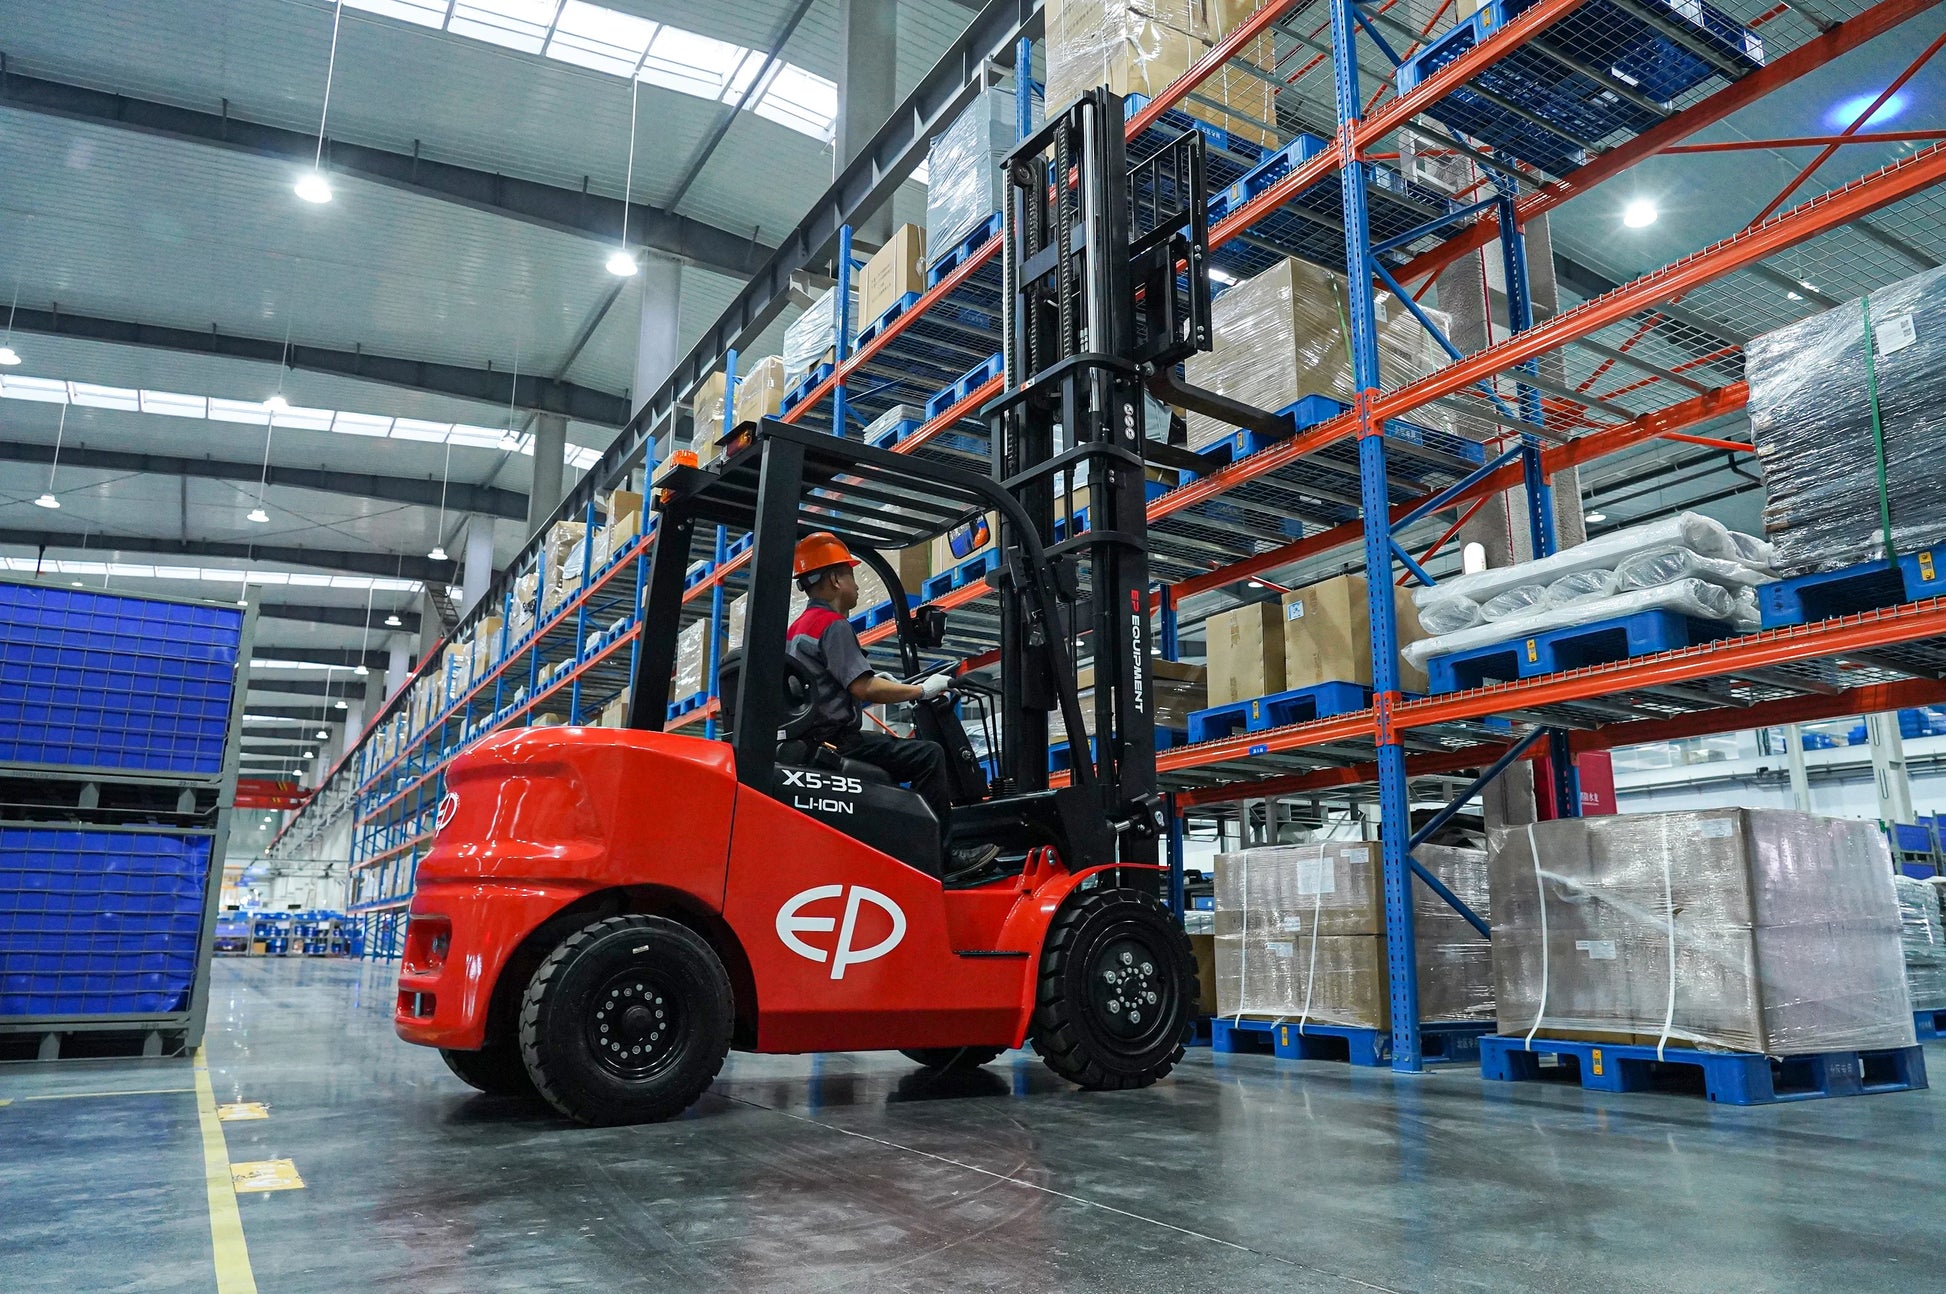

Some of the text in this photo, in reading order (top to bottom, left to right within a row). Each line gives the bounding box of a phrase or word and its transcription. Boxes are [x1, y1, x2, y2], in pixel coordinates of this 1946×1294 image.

[1131, 589, 1144, 714] EP EQUIPMENT
[782, 769, 862, 794] X5-35
[794, 795, 854, 815] LI-ION
[775, 884, 907, 980] EP
